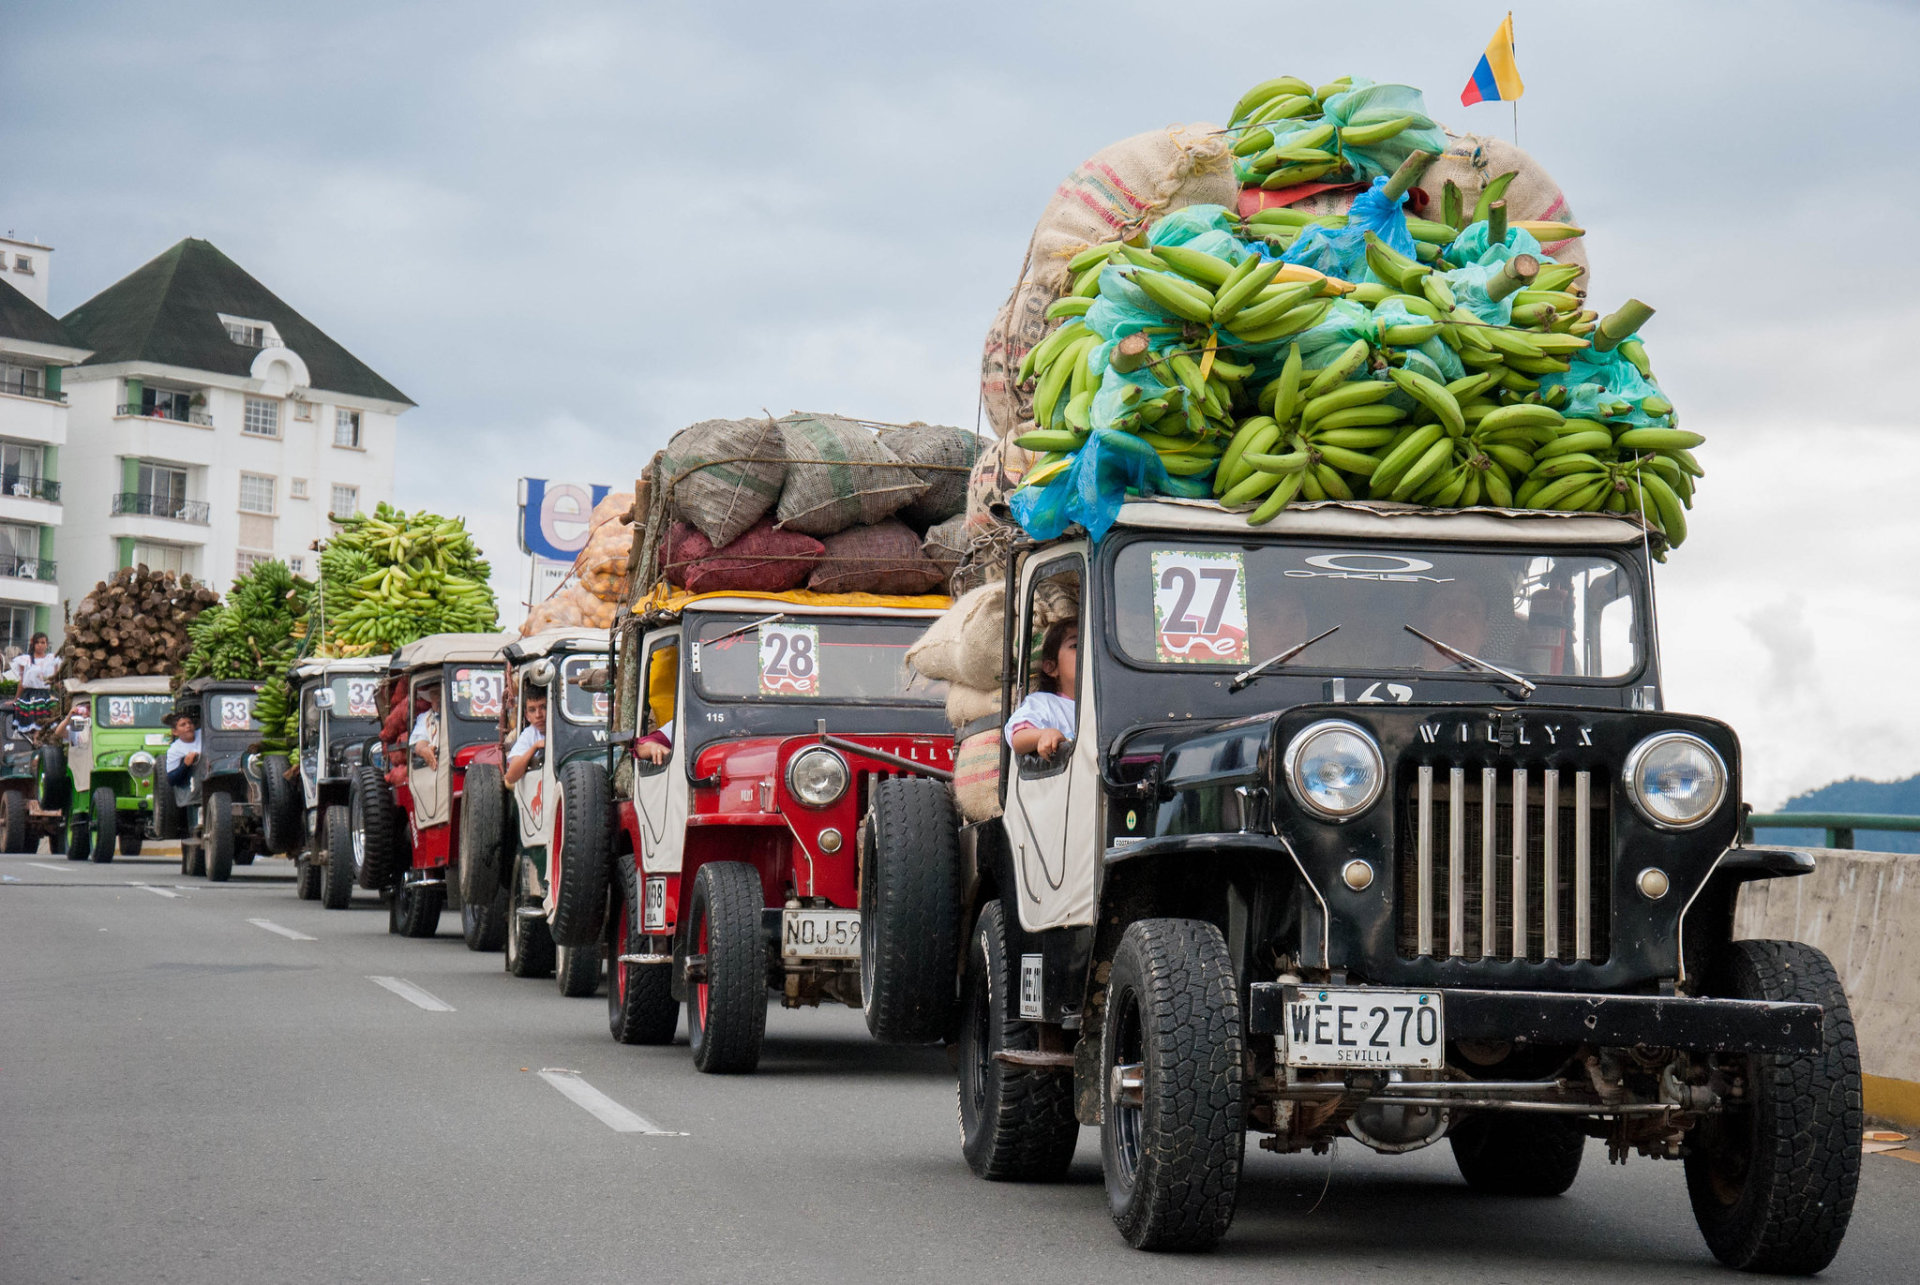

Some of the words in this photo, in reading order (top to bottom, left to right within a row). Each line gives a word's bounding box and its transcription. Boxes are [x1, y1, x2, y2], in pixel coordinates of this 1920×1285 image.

[1160, 566, 1238, 633] 27
[765, 633, 813, 677] 28
[351, 683, 376, 706] 32
[475, 676, 502, 704] 31
[112, 701, 131, 717] 34
[224, 702, 247, 721] 33
[706, 713, 725, 722] 115
[1418, 724, 1592, 747] WILLYS
[787, 920, 830, 944] NOJ
[1291, 1004, 1358, 1047] WEE
[1369, 1006, 1438, 1048] 270
[1338, 1049, 1391, 1062] SEVILLA
